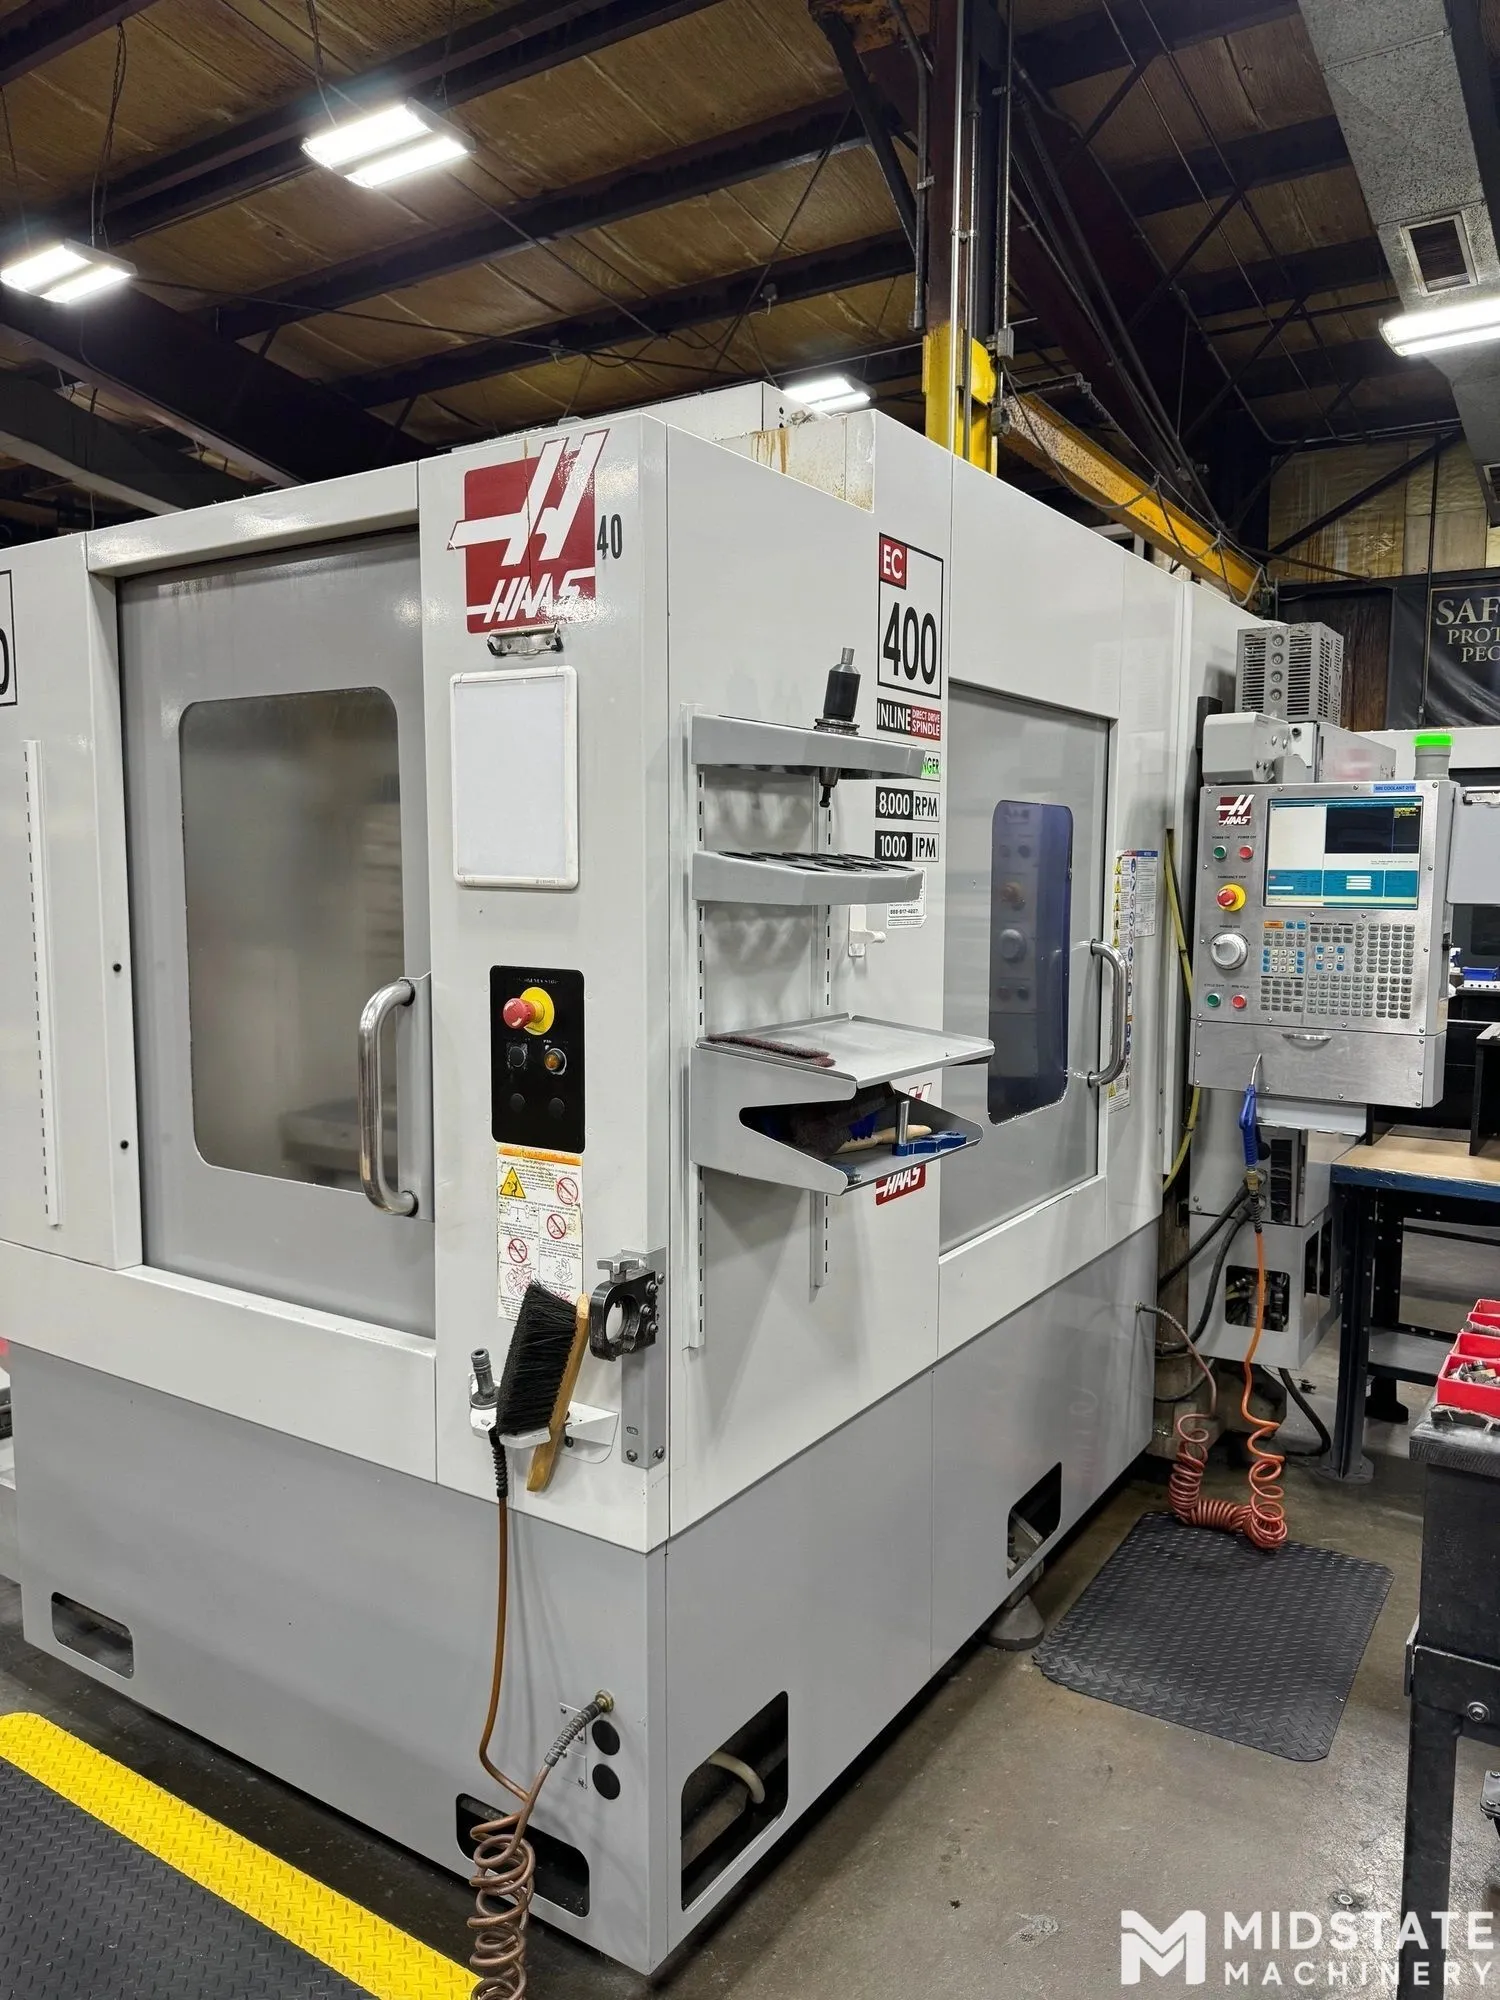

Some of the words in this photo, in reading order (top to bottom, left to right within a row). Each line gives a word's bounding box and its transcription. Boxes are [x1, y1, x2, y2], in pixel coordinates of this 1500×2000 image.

[597, 513, 623, 560] 40
[883, 543, 903, 579] EC
[467, 566, 596, 624] HAAS
[1436, 596, 1500, 625] SAF
[883, 602, 937, 685] 400
[1447, 627, 1500, 645] PROT
[877, 702, 912, 731] INLINE
[912, 709, 927, 721] DIRECT
[928, 712, 940, 723] DRIVE
[912, 720, 940, 736] SPINDLE
[879, 791, 910, 816] 8,000
[915, 796, 937, 817] RPM
[1219, 816, 1251, 826] HAAS
[880, 835, 907, 857] 1000
[915, 837, 936, 857] IPM
[876, 1166, 921, 1197] HAAS
